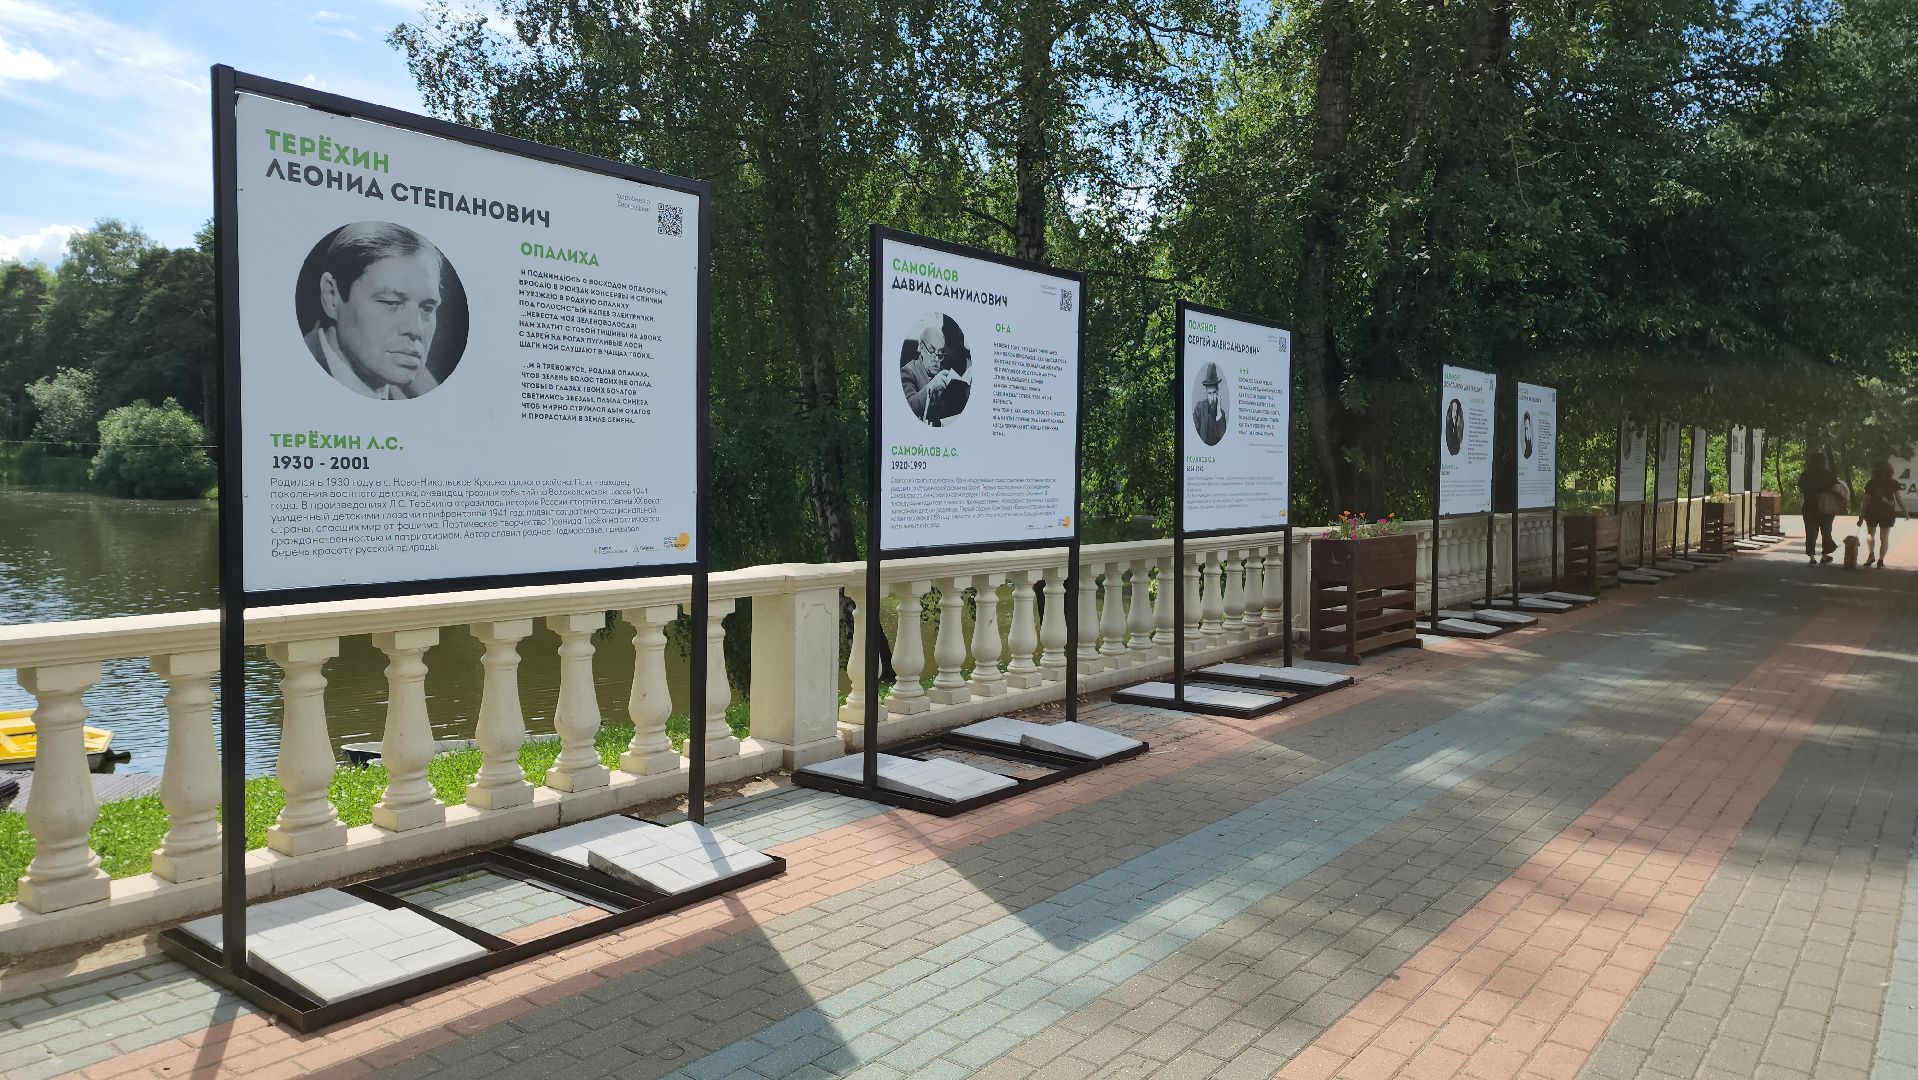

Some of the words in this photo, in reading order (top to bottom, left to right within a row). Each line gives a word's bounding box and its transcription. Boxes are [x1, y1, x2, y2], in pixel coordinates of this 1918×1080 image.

[265, 128, 388, 173] ТЕРЁХИН
[266, 156, 384, 199] ЛЕОНИД
[391, 180, 549, 229] СТЕПАНОВИЧ
[520, 241, 598, 266] ОПАЛИХА
[892, 257, 958, 283] САМОЙЛОВ
[527, 269, 580, 282] ПОДНИМАЮСЬ
[589, 278, 626, 289] ВОСХОДОМ
[518, 278, 551, 289] БРОСАЮ
[560, 284, 588, 294] РЮКЗАК
[590, 288, 628, 299] КОНСЕРВЫ
[635, 294, 662, 304] СПИЧКИ
[892, 275, 932, 295] ДАВИД
[934, 283, 1007, 308] САМУИЛОВИЧ
[526, 290, 557, 300] УЕЗЖАЮ
[566, 295, 596, 304] РОДНУЮ
[598, 299, 629, 309] ОПАЛИХУ
[536, 301, 586, 313] ГОЛОСИСТЫЙ
[588, 308, 609, 316] НАПЕВ
[536, 322, 562, 330] ХВАТИТ
[572, 326, 595, 334] ТОБОЙ
[597, 328, 627, 337] ТИШИНЫ
[526, 330, 549, 339] ЗАРЕЙ
[587, 337, 622, 346] ПУГЛИВЫЕ
[1188, 334, 1210, 346] СЕРГЕЙ
[560, 344, 595, 353] СЛУШАЮТ
[542, 363, 586, 372] ТРЕВОЖУСЬ,
[521, 392, 564, 400] СВЕТИЛИСЬ
[270, 431, 361, 449] ТЕРЁХИН
[365, 435, 403, 450] Л.С.
[891, 445, 940, 456] САМОЙЛОВ
[943, 447, 958, 457] Д.С.
[272, 456, 313, 469] 1930
[330, 456, 369, 469] 2001
[270, 478, 314, 486] Родился
[326, 478, 349, 486] 1930
[301, 501, 307, 509] В
[442, 518, 497, 528] Поэтическое
[355, 544, 393, 554] русской
